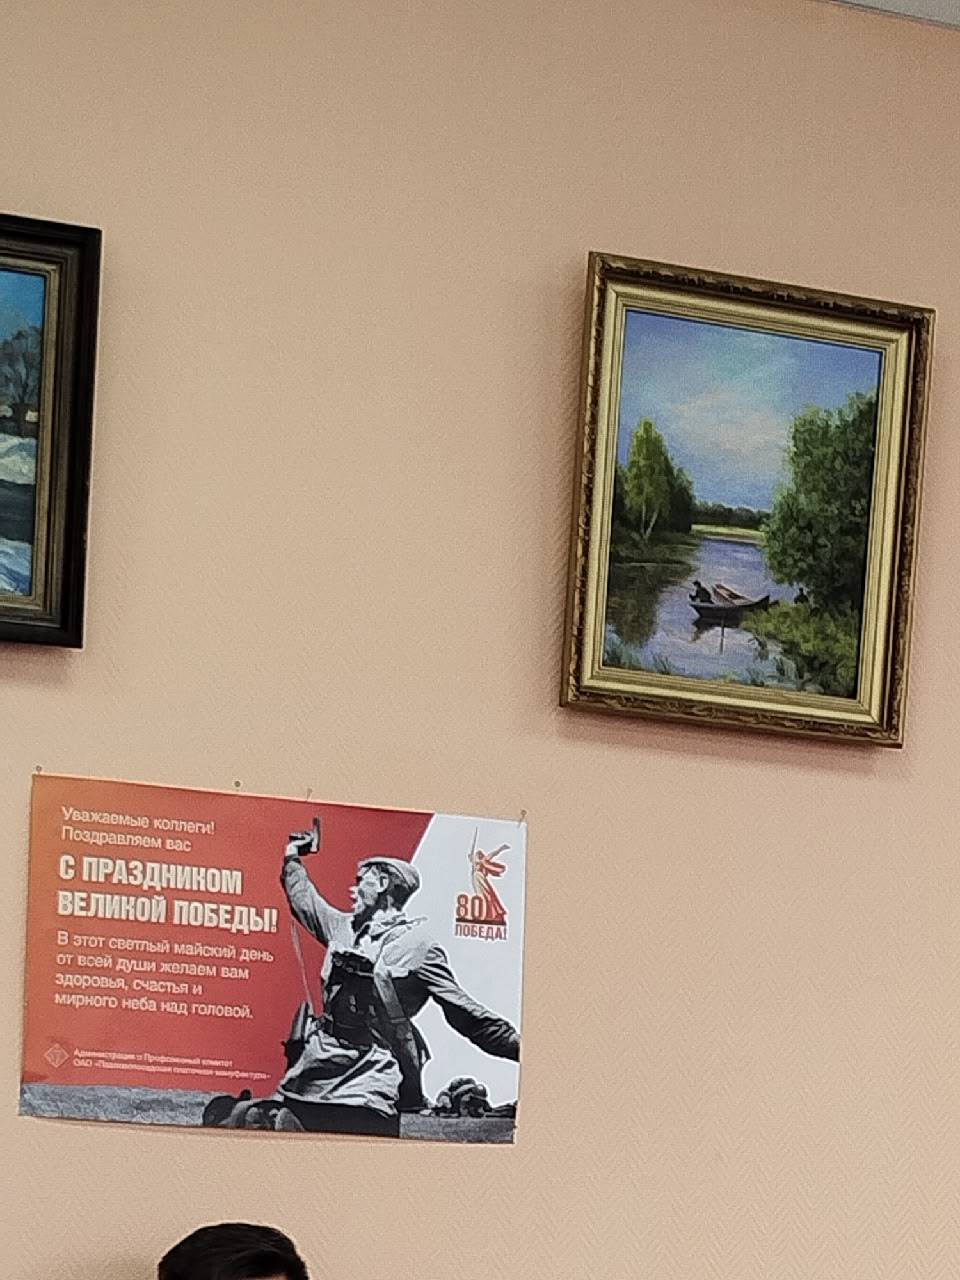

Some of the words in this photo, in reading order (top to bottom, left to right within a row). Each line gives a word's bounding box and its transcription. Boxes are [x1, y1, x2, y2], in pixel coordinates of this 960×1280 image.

[61, 806, 149, 828] Уважаемые
[154, 818, 215, 835] коллеги!
[61, 826, 162, 849] Поздравляем
[165, 840, 192, 852] вас
[59, 854, 76, 880] С
[82, 856, 242, 894] ПРАЗДНИКОМ
[57, 890, 167, 923] ВЕЛИКОЙ
[173, 900, 278, 934] ПОБЕДЫ!
[456, 894, 484, 920] 80
[454, 923, 507, 941] ПОБЕДА!
[57, 931, 69, 945] В
[73, 934, 105, 948] этот
[108, 937, 170, 953] светлый
[174, 942, 236, 959] майский
[239, 948, 274, 963] день
[56, 953, 73, 965] от
[77, 954, 113, 968] всей
[115, 957, 157, 973] души
[159, 962, 217, 977] желаем
[221, 967, 250, 980] вам
[55, 973, 129, 991] здоровья,
[132, 978, 188, 995] счастья
[192, 983, 203, 995] и
[54, 992, 119, 1009] мирного
[122, 996, 157, 1012] неба
[160, 1001, 188, 1016] над
[191, 1002, 254, 1019] головой.
[73, 1058, 93, 1067] ОАО
